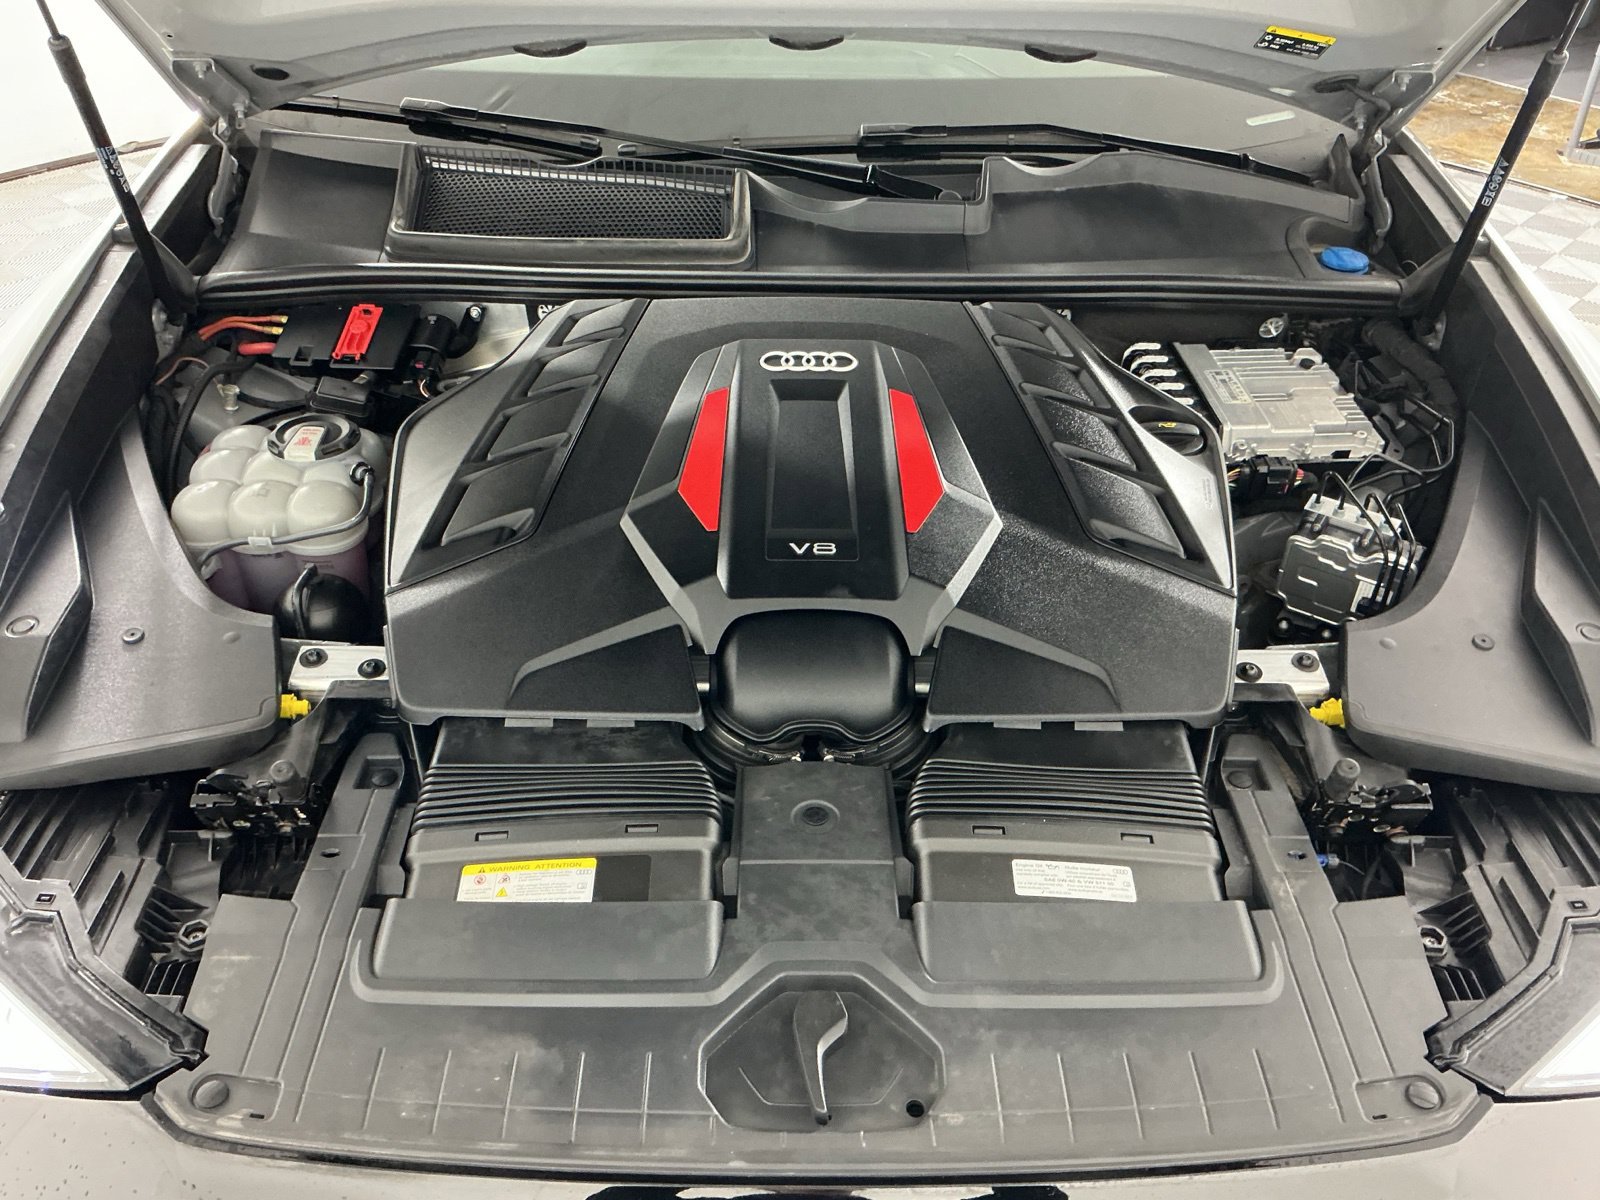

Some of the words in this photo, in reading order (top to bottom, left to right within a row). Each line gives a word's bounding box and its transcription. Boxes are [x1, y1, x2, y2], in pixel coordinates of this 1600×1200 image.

[788, 542, 837, 554] V8
[489, 864, 530, 872] WARNING
[535, 861, 582, 869] ATTENTION
